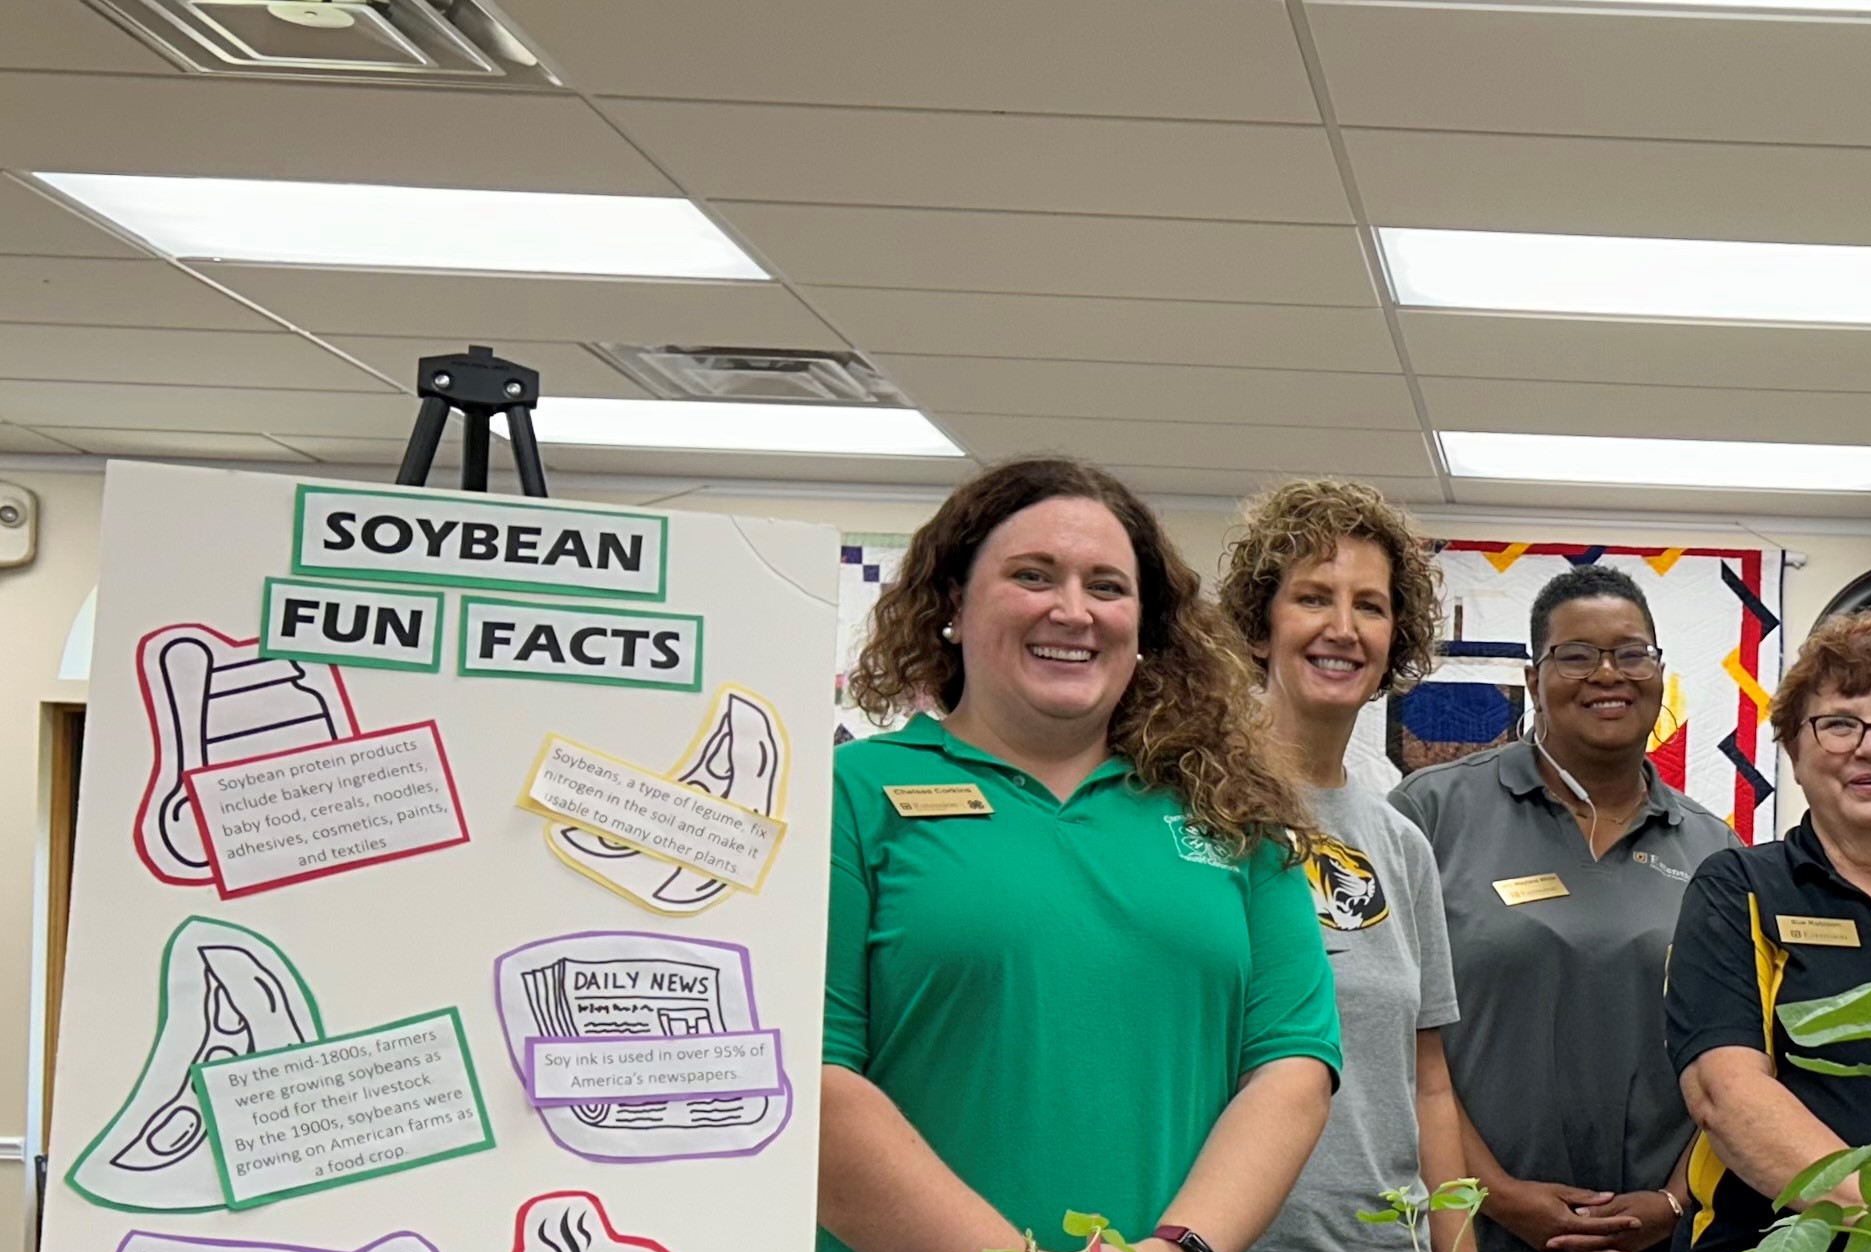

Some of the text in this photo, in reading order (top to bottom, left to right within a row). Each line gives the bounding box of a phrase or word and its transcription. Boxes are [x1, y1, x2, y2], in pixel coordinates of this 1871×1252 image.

[323, 511, 642, 571] SOYBEAN
[280, 597, 679, 669] FUN FACTS
[217, 741, 417, 791] Soybean protein products
[220, 762, 427, 814] include bakery ingredients,
[221, 783, 438, 836] baby food, cereals, noodles,
[227, 803, 447, 859] adhesives, cosmetics, paints,
[573, 971, 708, 994] DAILY NEWS
[228, 1031, 436, 1086] By the mid-1800s, farmers
[544, 1042, 764, 1068] Soy ink is used in over 95% of
